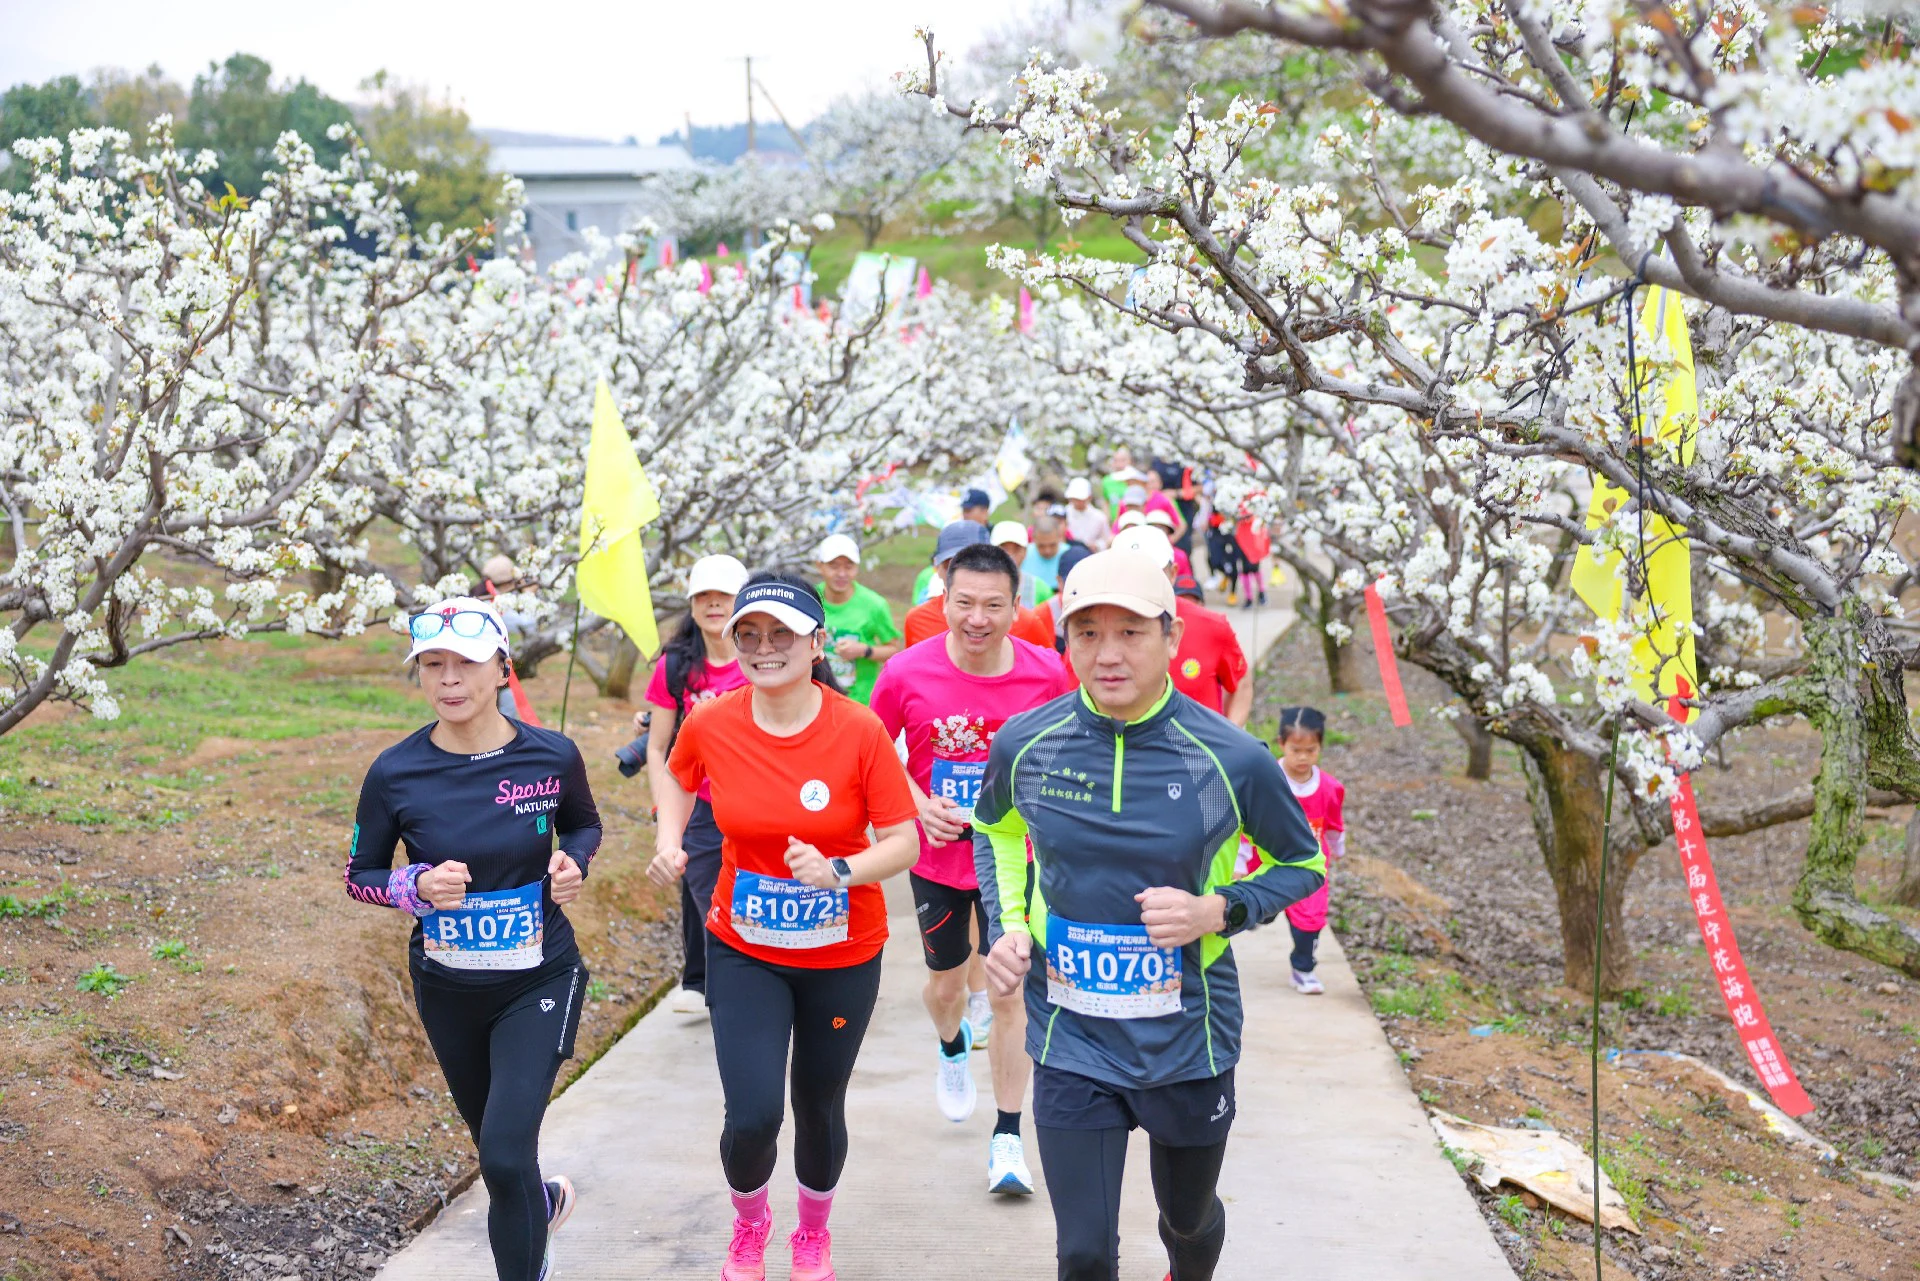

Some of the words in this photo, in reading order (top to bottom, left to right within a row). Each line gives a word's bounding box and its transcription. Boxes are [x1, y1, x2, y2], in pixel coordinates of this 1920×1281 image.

[495, 776, 560, 807] Sports
[746, 894, 834, 921] B1072
[438, 910, 535, 940] B1073
[1057, 943, 1164, 982] B1070
